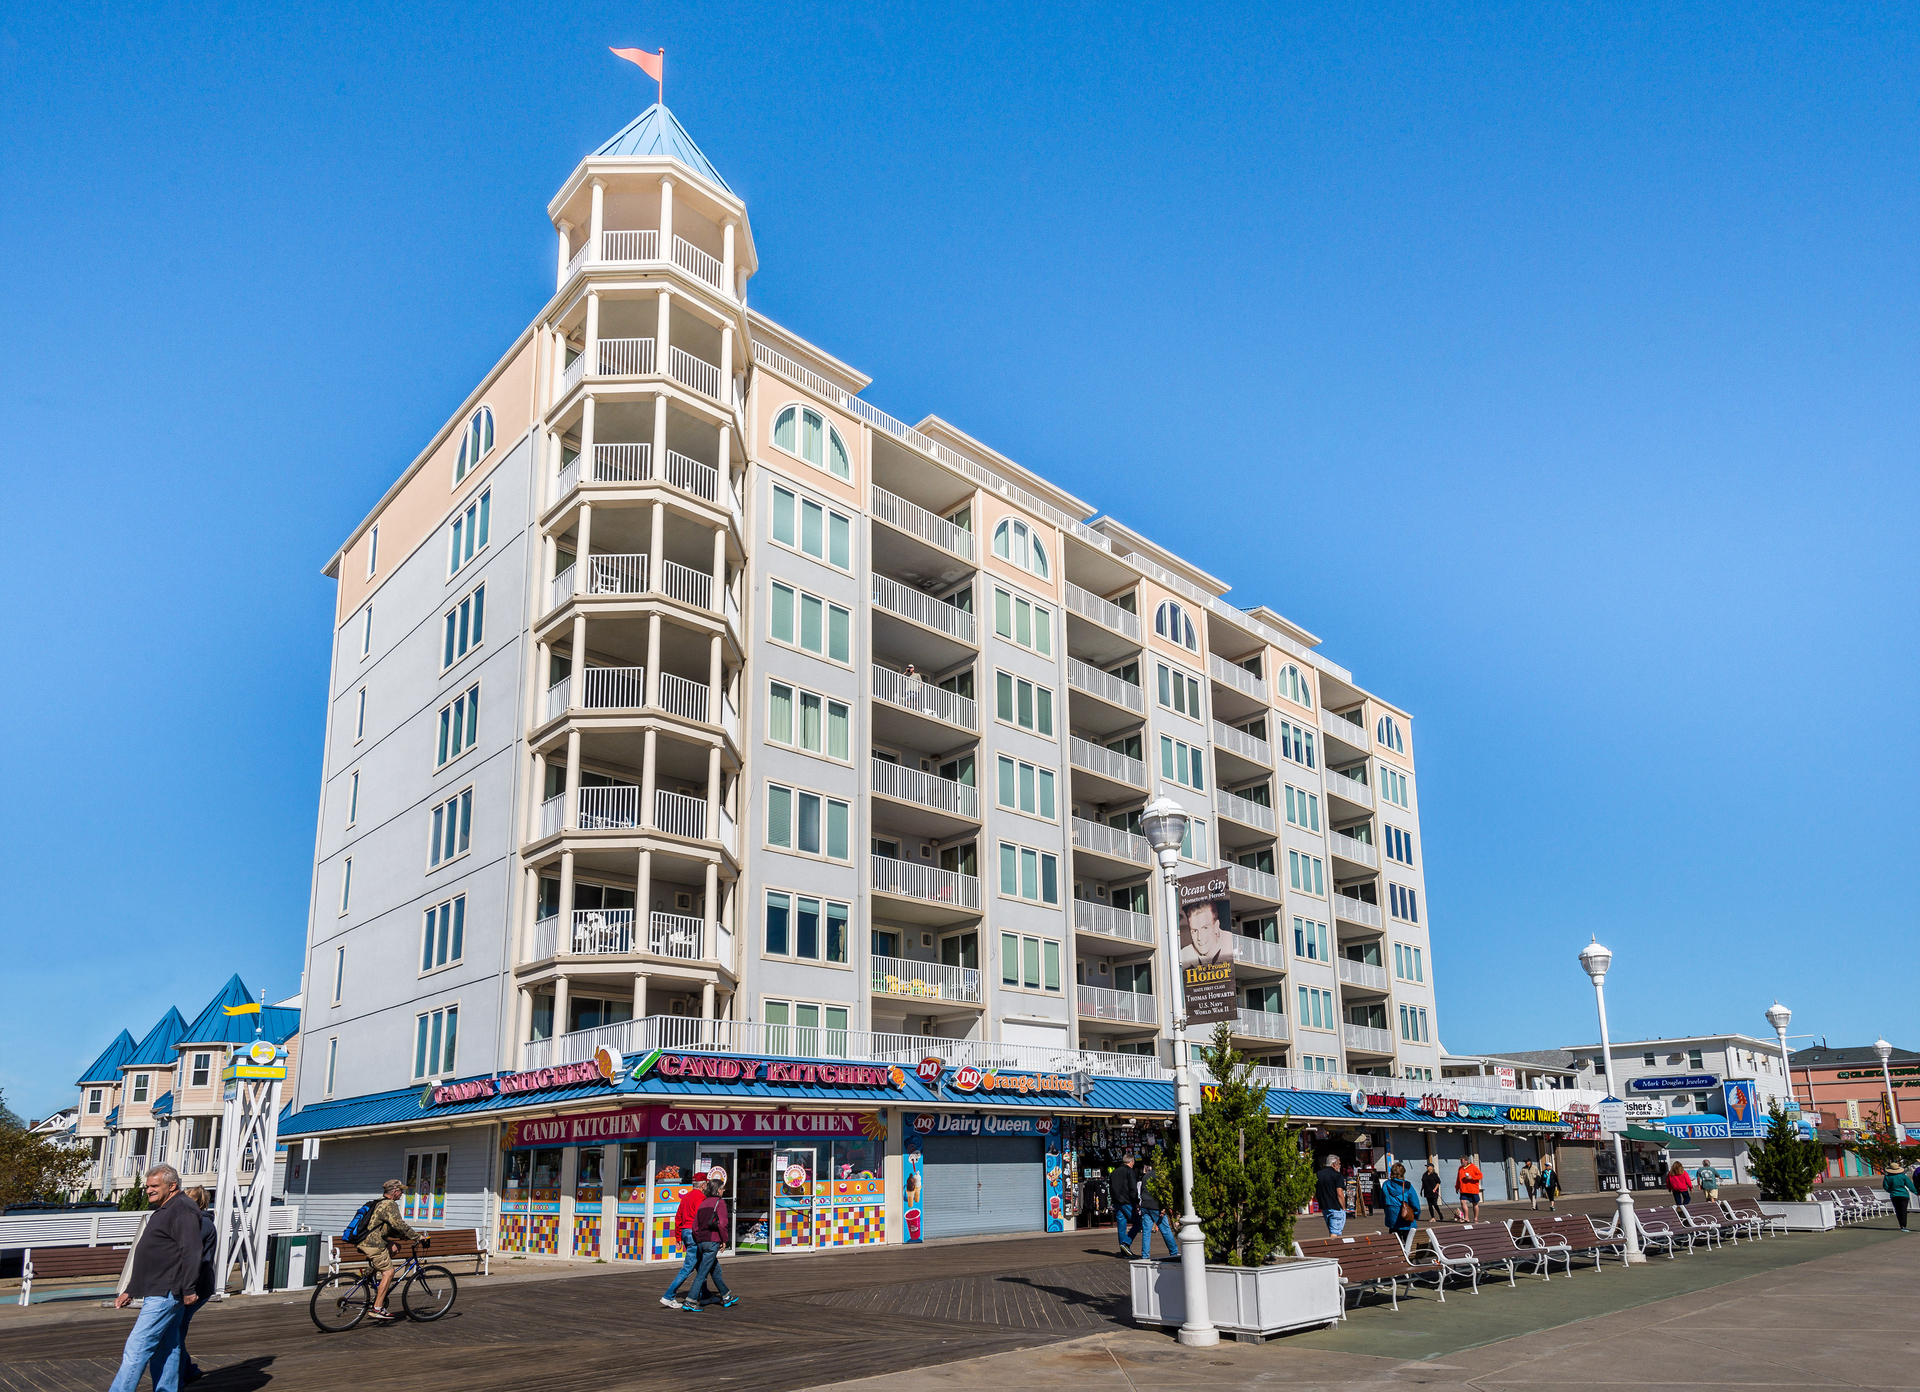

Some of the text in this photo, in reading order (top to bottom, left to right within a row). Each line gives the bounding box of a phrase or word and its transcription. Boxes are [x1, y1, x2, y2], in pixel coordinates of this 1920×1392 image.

[1180, 879, 1227, 897] Ocean City
[1181, 896, 1208, 904] Hometown
[1197, 961, 1231, 972] We Proudly
[1186, 968, 1231, 983] Honor
[659, 1055, 889, 1086] CANDY KITCHEN
[919, 1062, 937, 1078] DQ
[1495, 1067, 1514, 1077] T-SHIRT
[961, 1069, 1074, 1093] DQ Orange Julius
[1501, 1079, 1516, 1089] CTORY
[1661, 1078, 1684, 1087] Douglas
[1685, 1077, 1708, 1085] Jewelers
[434, 1078, 496, 1104] CANDY
[1420, 1096, 1460, 1113] JEWELRY
[660, 1112, 854, 1131] CANDY KITCHEN
[1509, 1107, 1535, 1121] OCEAN
[1537, 1110, 1560, 1123] WAVES
[522, 1113, 642, 1141] CANDY KITCHEN
[916, 1113, 1051, 1136] DQ Dairy Queen DQ
[1694, 1125, 1728, 1138] BROS.
